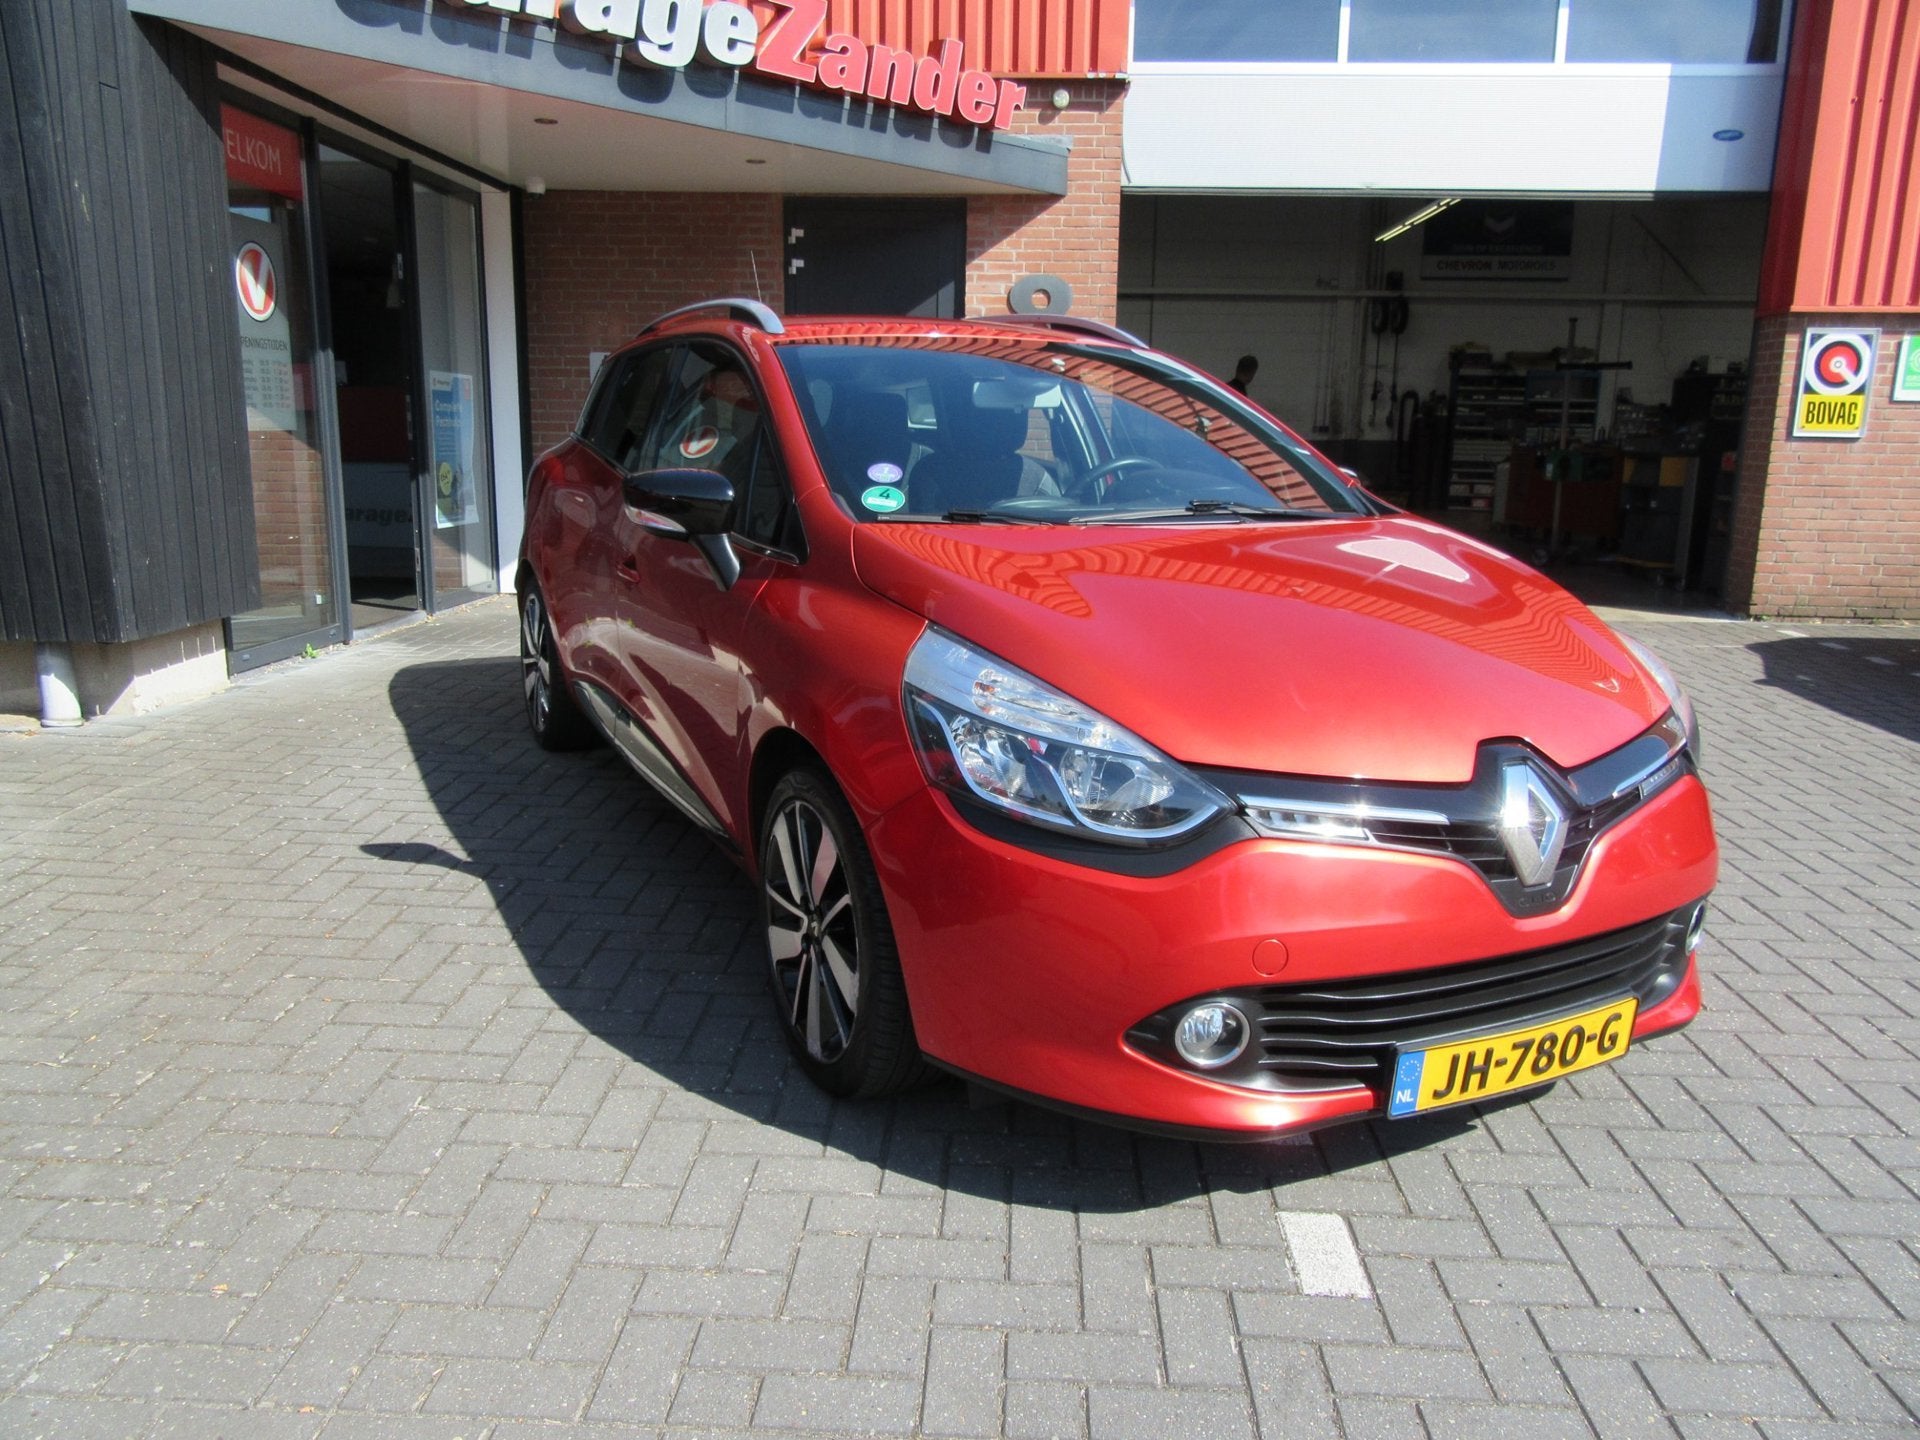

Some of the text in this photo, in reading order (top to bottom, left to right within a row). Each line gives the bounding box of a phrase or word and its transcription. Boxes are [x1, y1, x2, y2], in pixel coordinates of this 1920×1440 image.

[223, 127, 282, 175] ELKOM
[1436, 260, 1492, 272] CHEVRON
[240, 335, 288, 352] PENINGSTIJDEN
[1805, 401, 1858, 425] BOVAG
[879, 488, 891, 500] 4
[346, 508, 408, 527] arage
[1431, 1012, 1622, 1100] JH-780-G
[1395, 1089, 1414, 1104] NL
